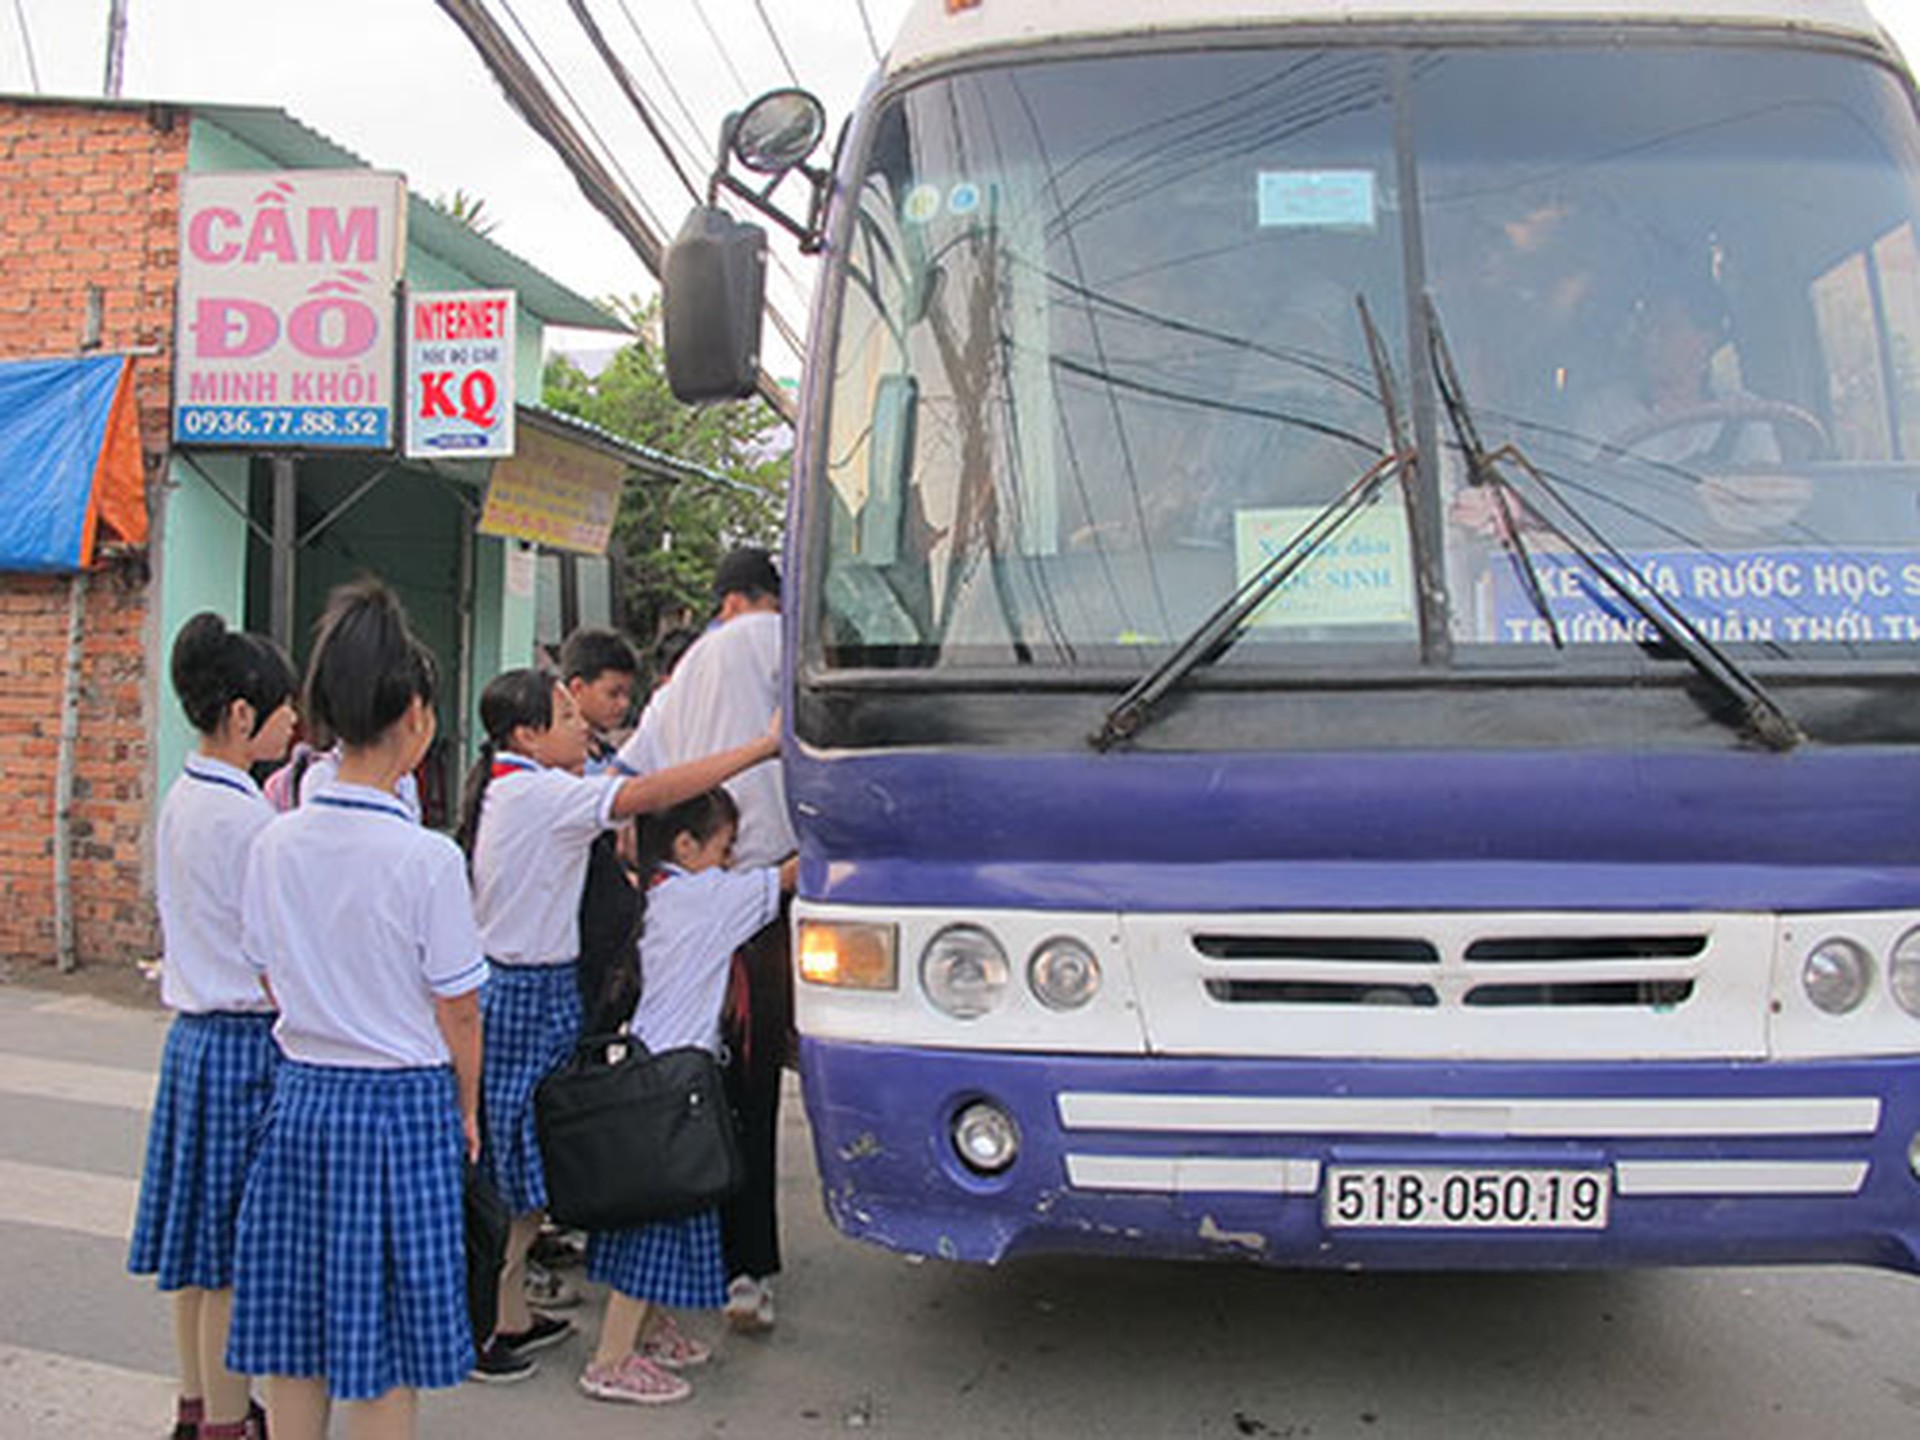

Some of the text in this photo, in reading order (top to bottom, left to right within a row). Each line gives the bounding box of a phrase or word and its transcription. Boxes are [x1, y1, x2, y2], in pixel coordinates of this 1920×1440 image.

[187, 181, 379, 264] CẦM
[189, 270, 379, 359] ĐỒ
[415, 300, 508, 340] INTERNET
[189, 363, 378, 403] MINH KHÔI
[419, 369, 497, 429] KQ
[184, 410, 378, 435] 0936.77.88.52
[1693, 556, 1801, 598] RƯỚC
[1814, 563, 1891, 606] HỌC
[1684, 609, 1773, 641] UÂN
[1337, 1175, 1600, 1221] 51B-050.19
